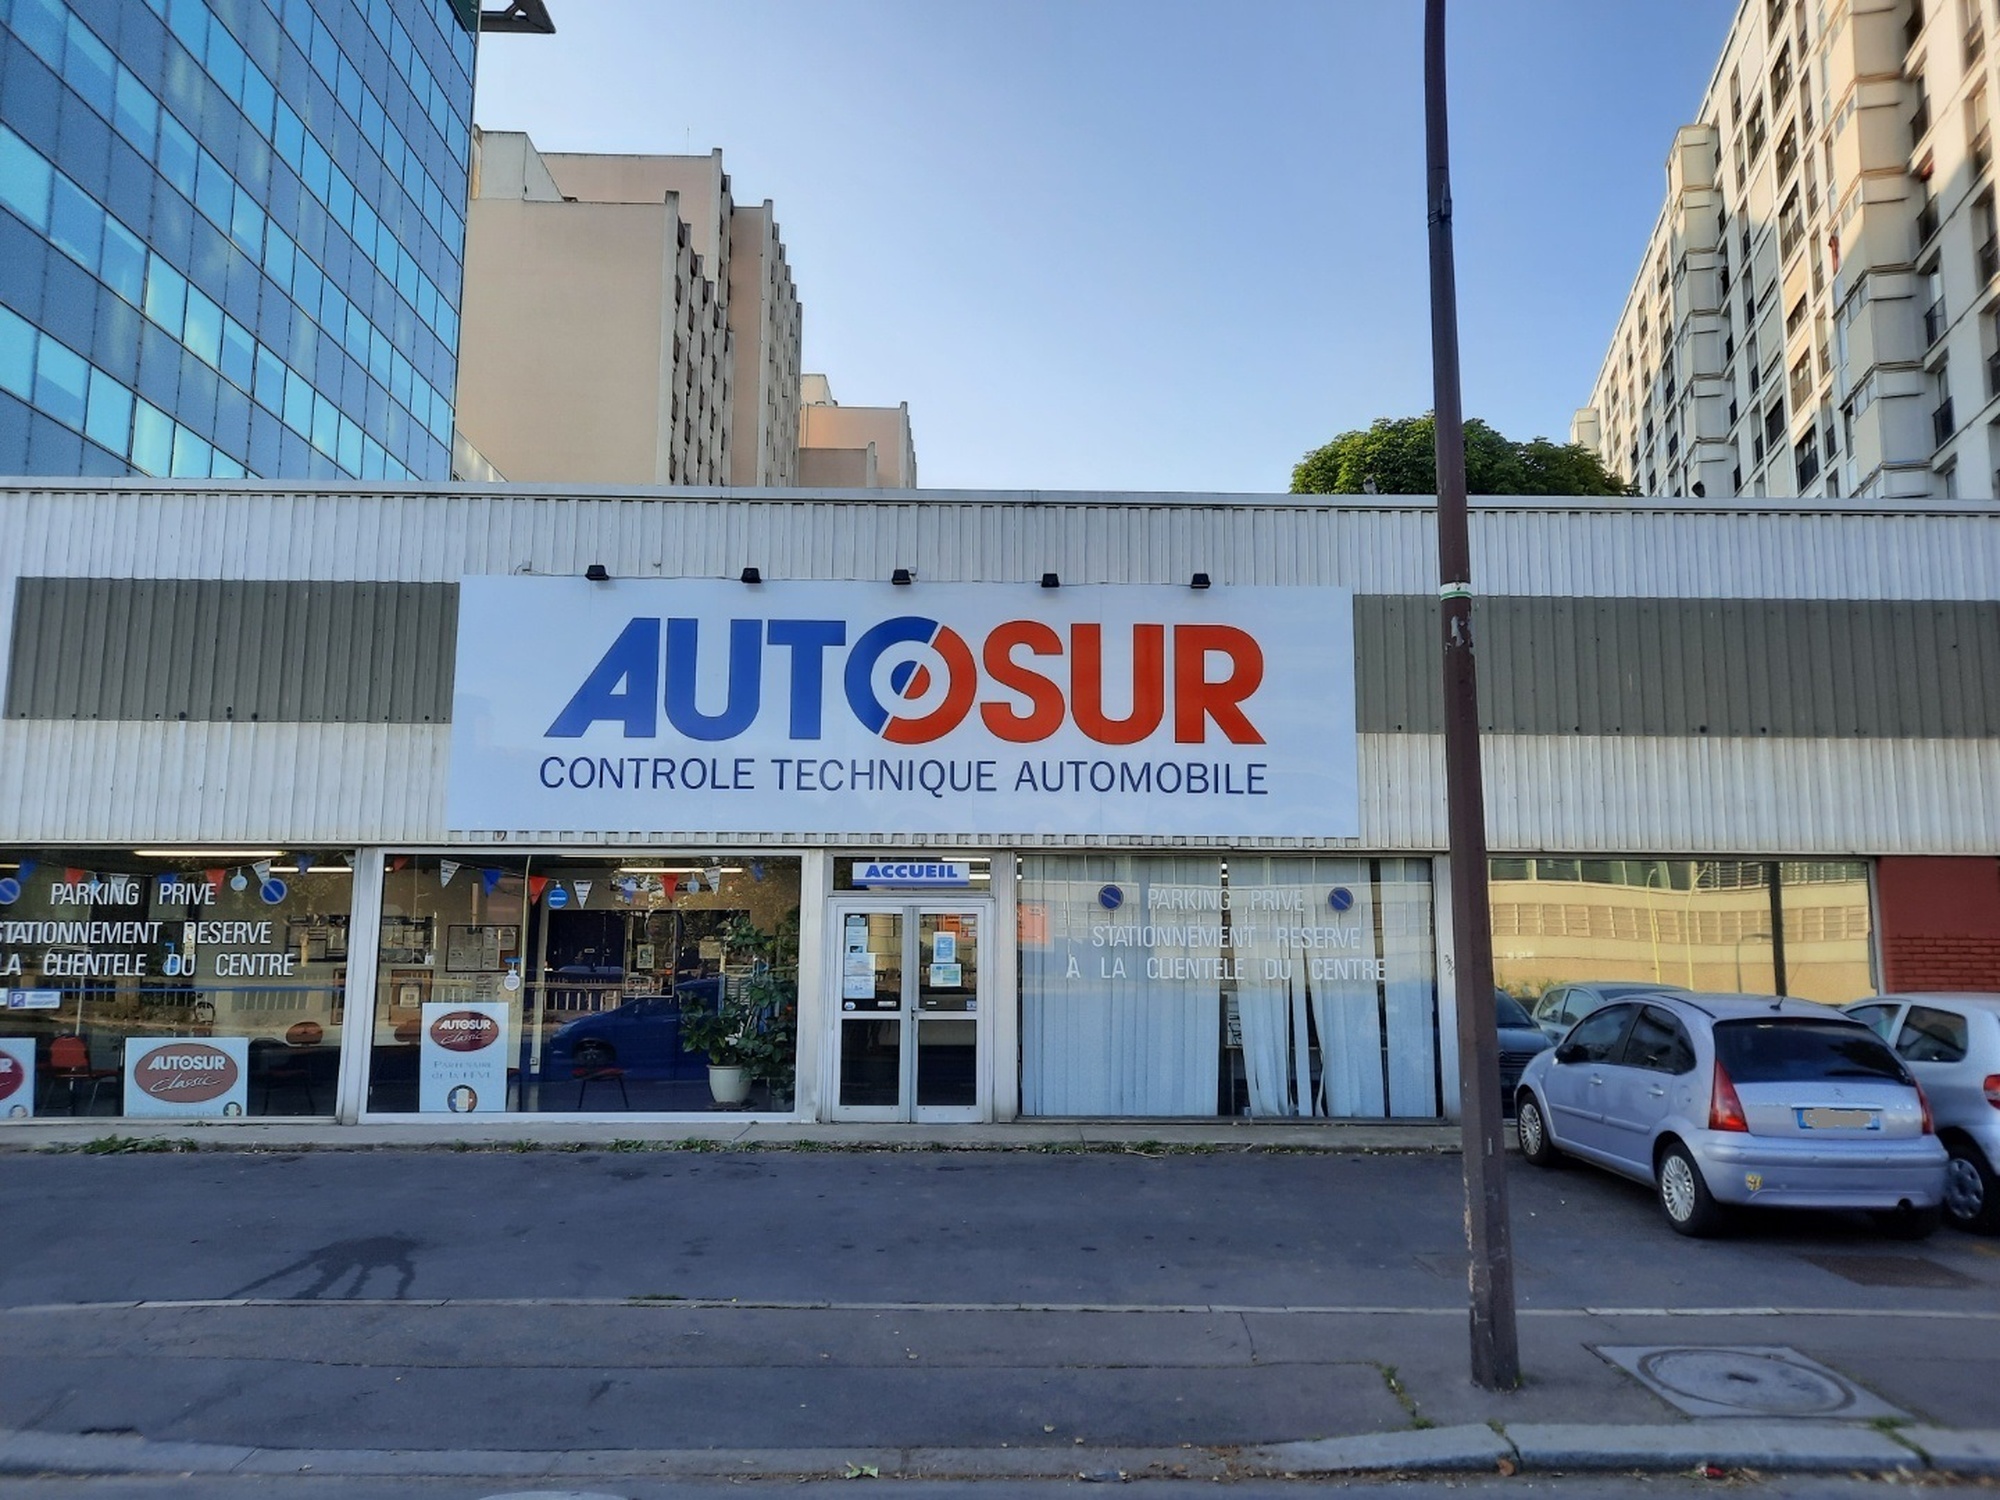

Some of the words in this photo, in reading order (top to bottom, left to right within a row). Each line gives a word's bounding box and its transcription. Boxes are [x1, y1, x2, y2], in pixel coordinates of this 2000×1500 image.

[544, 616, 1267, 745] AUTOSUR
[540, 756, 755, 790] CONTROLE
[772, 757, 997, 797] TECHNIQUE
[1015, 761, 1268, 795] AUTOMOBILE
[865, 864, 958, 879] ACCUEIL
[50, 882, 140, 906] PARKING
[158, 882, 217, 906] PRIVE
[1147, 888, 1232, 911] PARKING
[1250, 889, 1305, 912] PRIVE
[183, 921, 273, 945] RESERVE
[1092, 925, 1257, 949] STATIONNEMENT
[1276, 926, 1362, 950] RESERVE
[43, 953, 147, 977] CLIENTELE
[167, 953, 197, 976] DU
[215, 953, 296, 977] CENTRE
[1101, 956, 1127, 979] LA
[1147, 957, 1245, 981] CLIENTELE
[1264, 957, 1292, 981] DU
[1311, 957, 1387, 982] CENTRE
[439, 1019, 491, 1030] AUTOSUR
[147, 1056, 226, 1071] AUTOSUR
